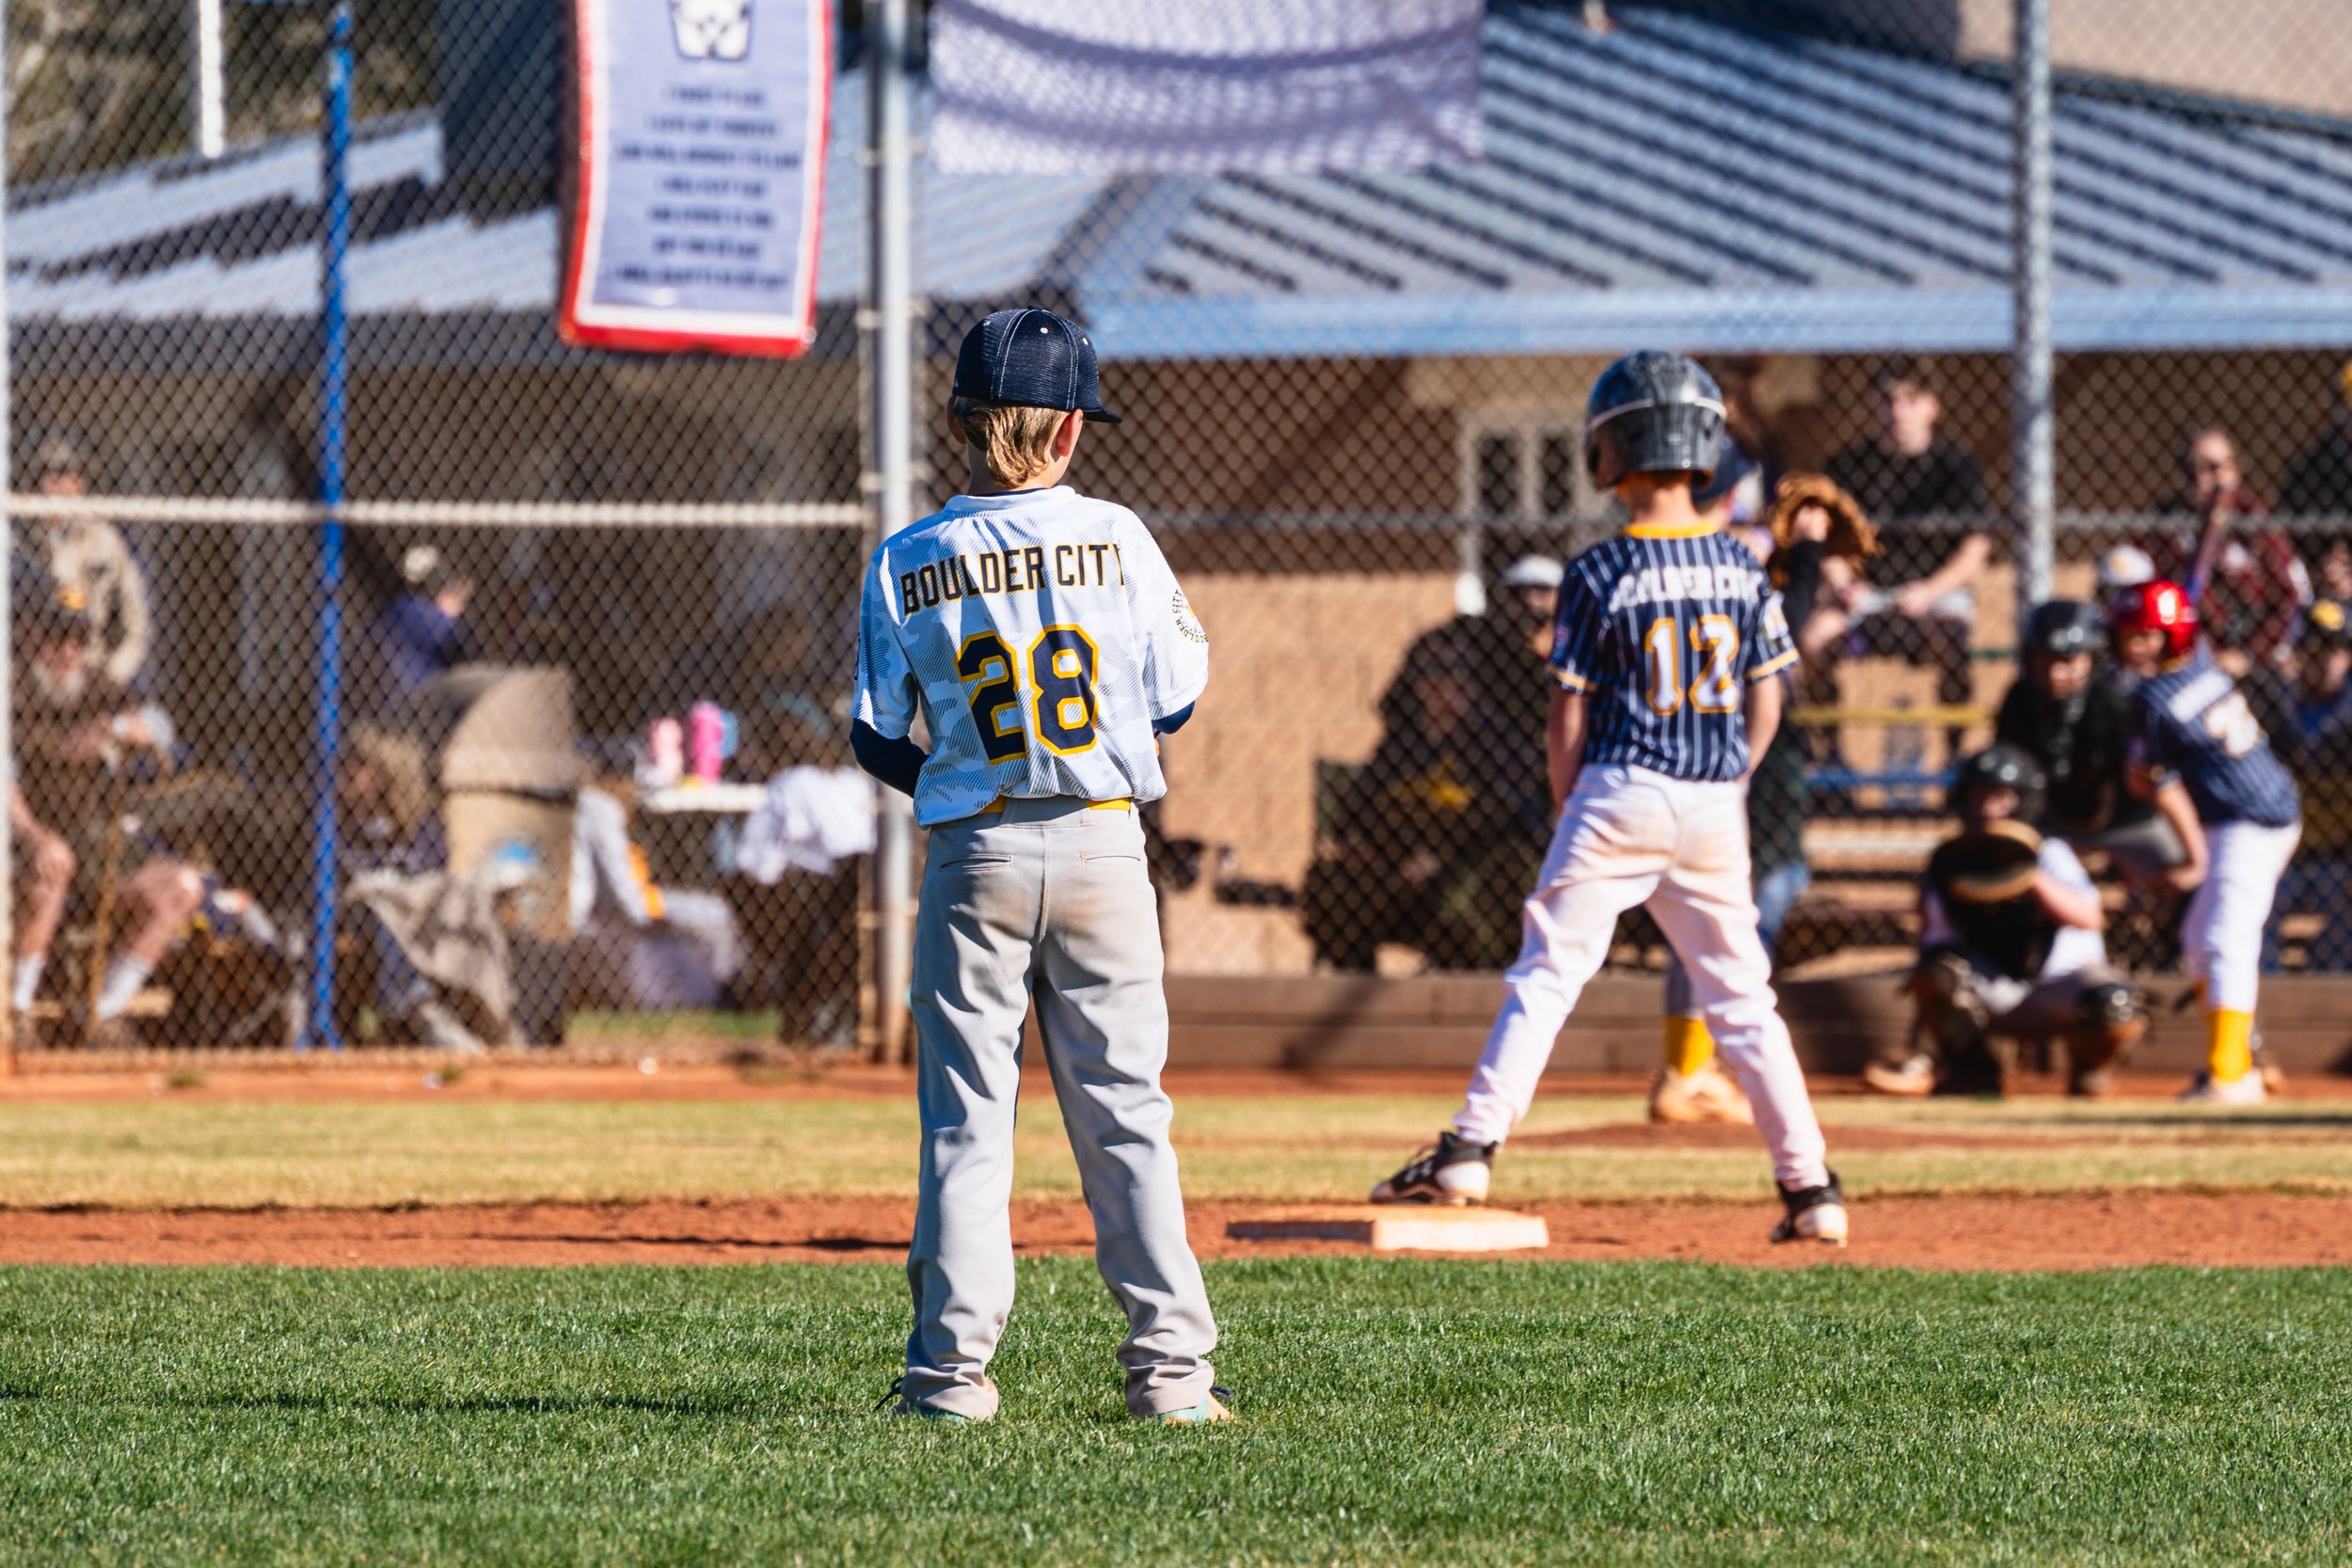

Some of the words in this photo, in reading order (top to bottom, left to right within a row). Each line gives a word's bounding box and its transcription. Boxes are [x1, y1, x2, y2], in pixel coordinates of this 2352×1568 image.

[899, 545, 1047, 616] BOULDER
[954, 624, 1099, 765] 28
[1645, 615, 1739, 716] 12
